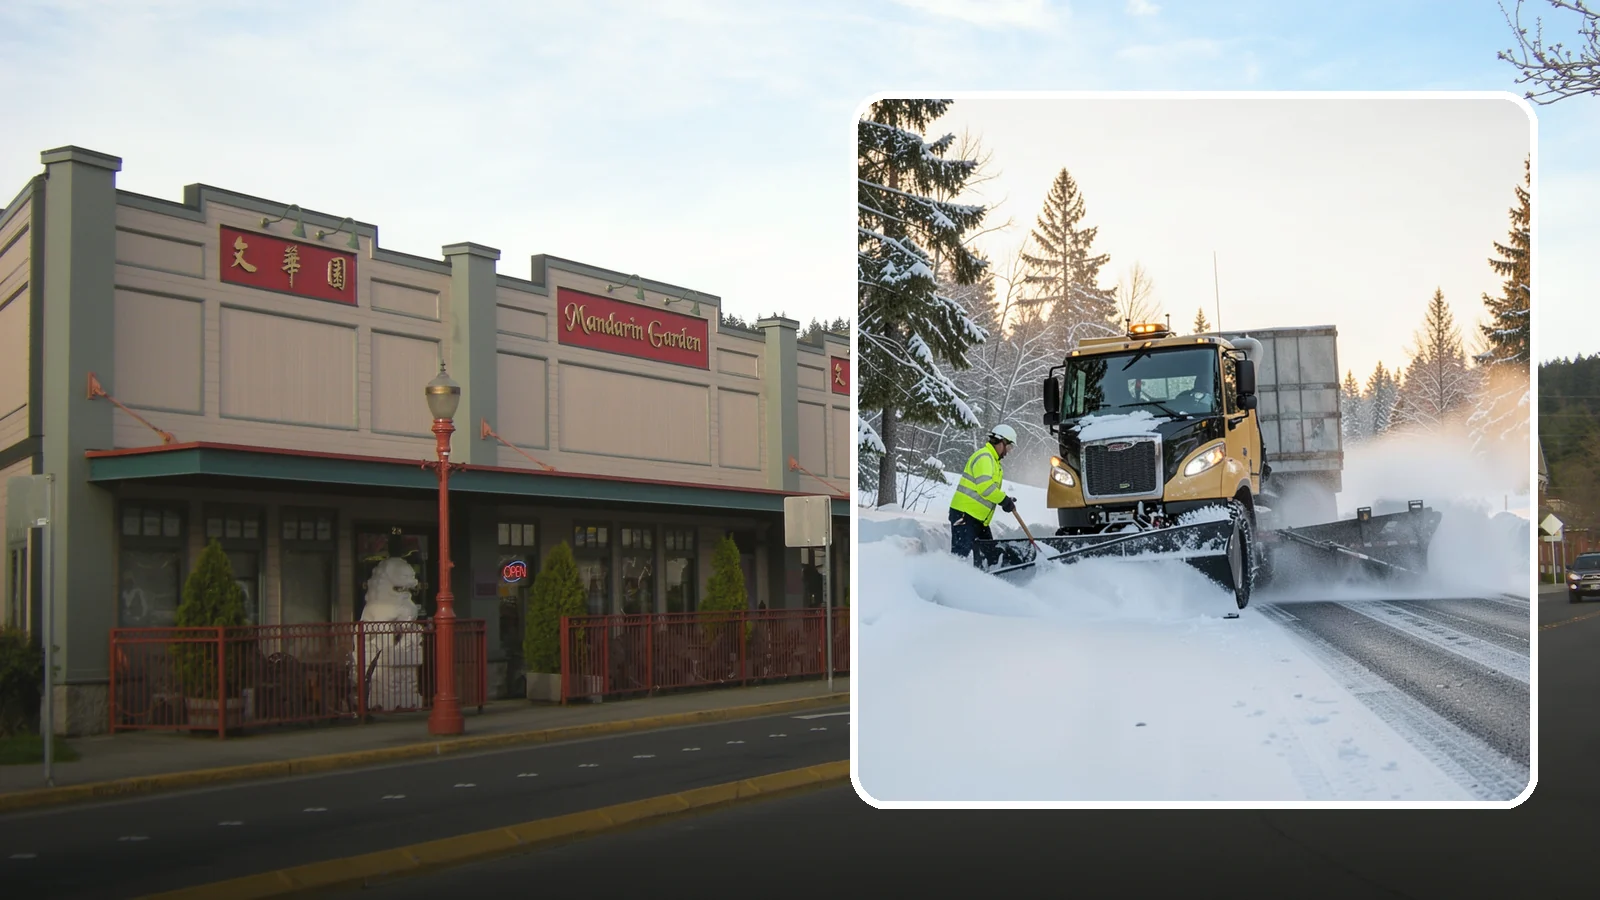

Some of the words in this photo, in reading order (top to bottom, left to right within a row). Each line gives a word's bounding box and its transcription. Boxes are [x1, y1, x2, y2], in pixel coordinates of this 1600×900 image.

[231, 236, 345, 290] 文華園
[564, 302, 644, 340] Mandarin
[649, 320, 702, 352] Garden
[835, 363, 846, 386] 文
[503, 565, 527, 578] OPEN
